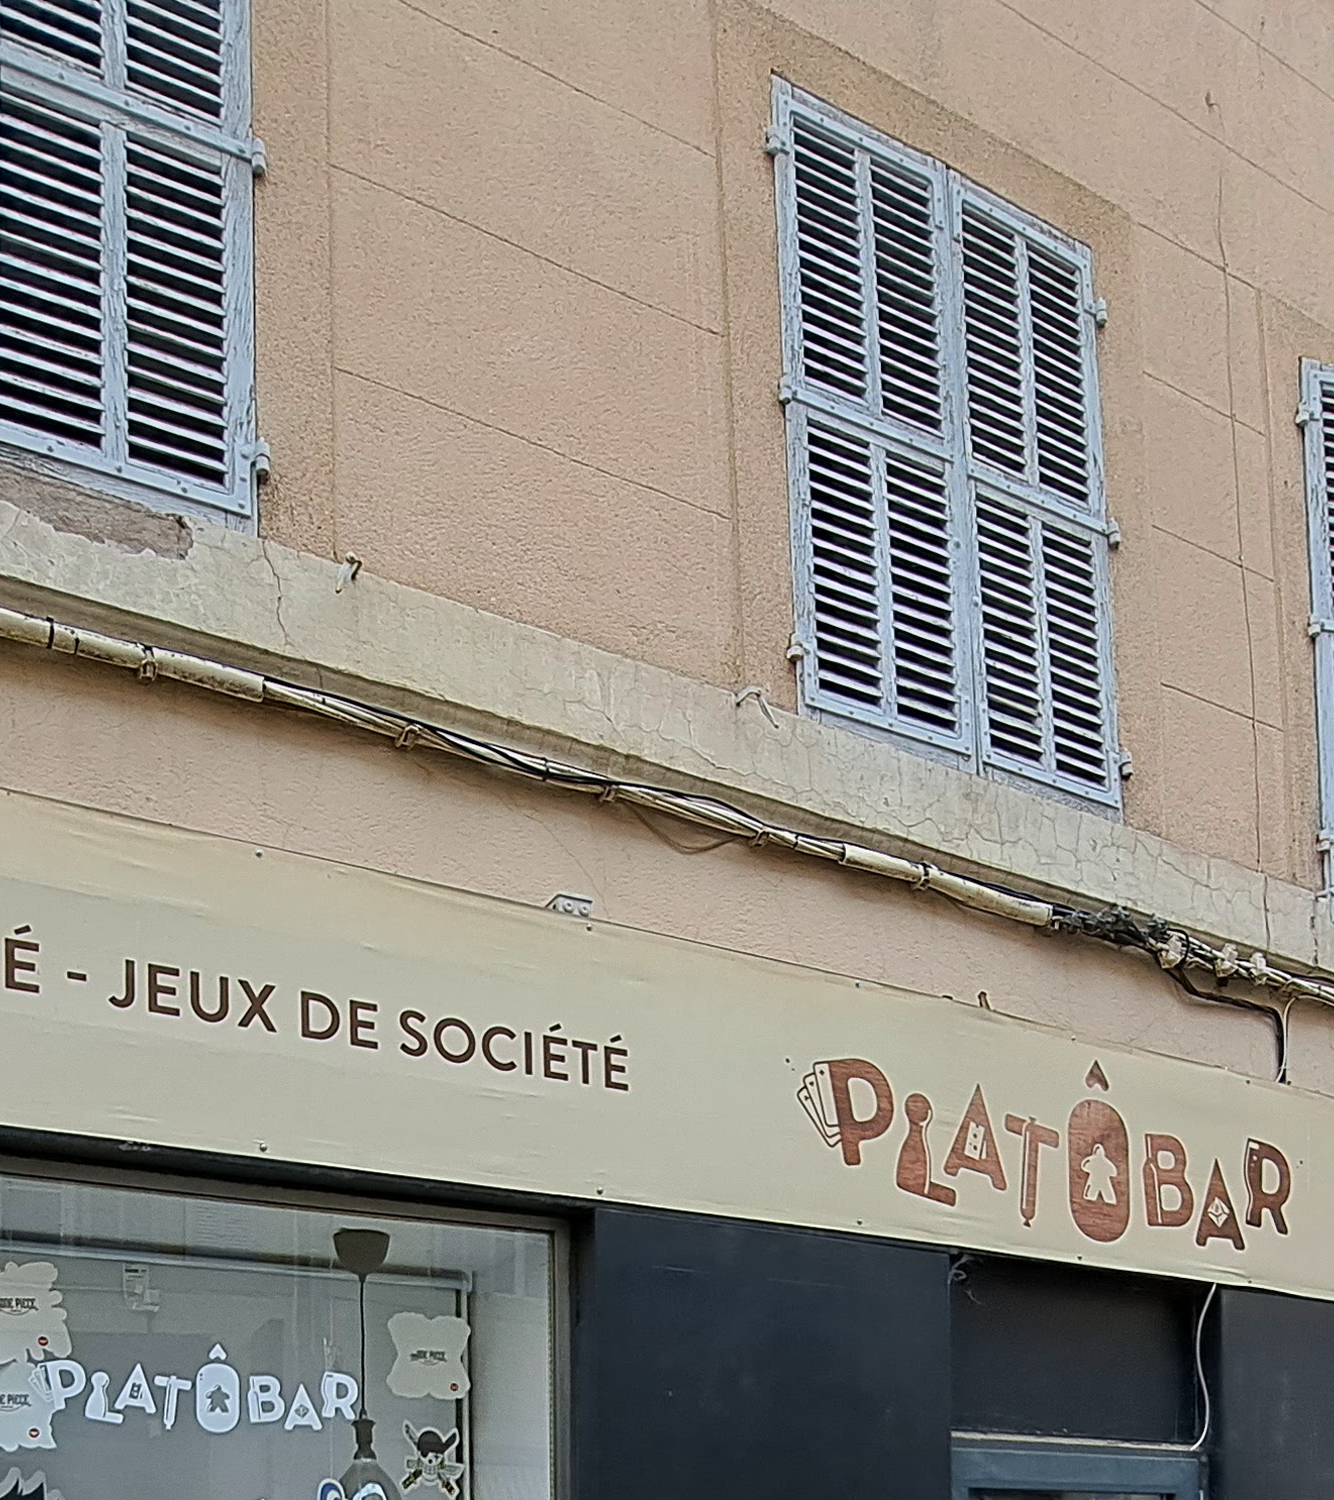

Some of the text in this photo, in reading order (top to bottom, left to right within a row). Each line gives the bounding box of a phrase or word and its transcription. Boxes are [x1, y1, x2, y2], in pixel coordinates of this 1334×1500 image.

[108, 958, 278, 1034] JEUX
[299, 991, 380, 1051] DE
[398, 1009, 630, 1092] SOCIÉTÉ
[797, 1058, 1292, 1252] PLATÔBAR
[28, 1343, 360, 1434] PLATÔBAR
